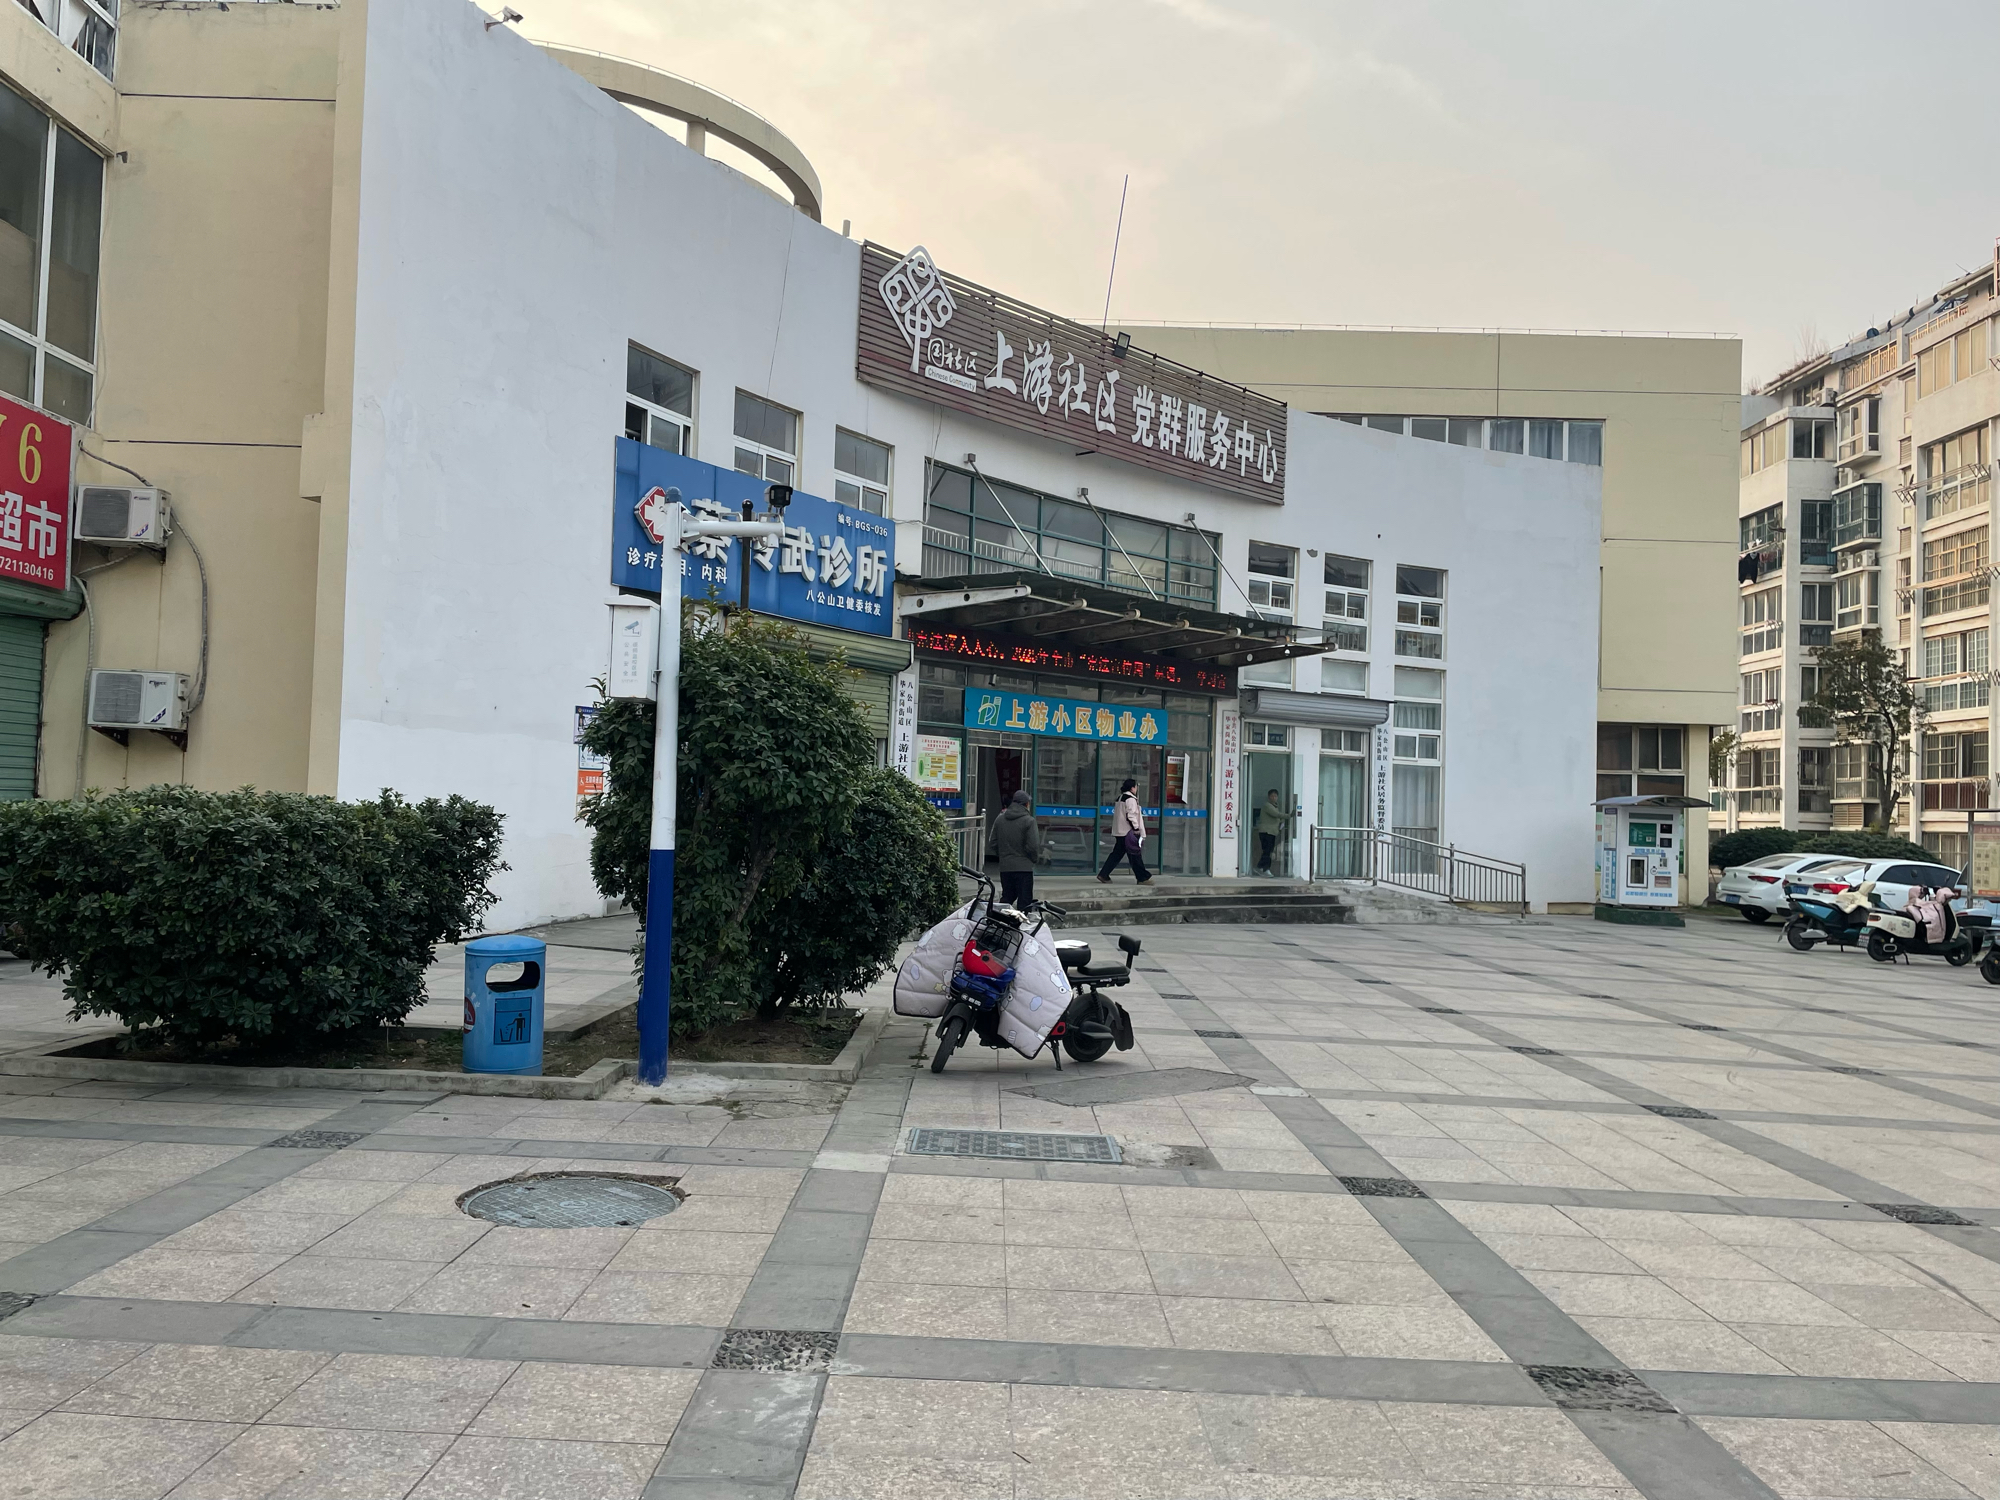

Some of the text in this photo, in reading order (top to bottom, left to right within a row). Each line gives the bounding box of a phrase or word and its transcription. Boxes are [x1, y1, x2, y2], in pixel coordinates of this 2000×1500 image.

[928, 368, 976, 392] Chinese Community
[984, 330, 1279, 484] 上游社区 党群服务中心
[0, 491, 62, 559] 超市
[806, 589, 881, 617] 八公山卫健委核发
[1005, 699, 1158, 741] 上游小区物业办
[898, 732, 909, 774] 上游社区
[1224, 758, 1234, 833] 上游社区委员会
